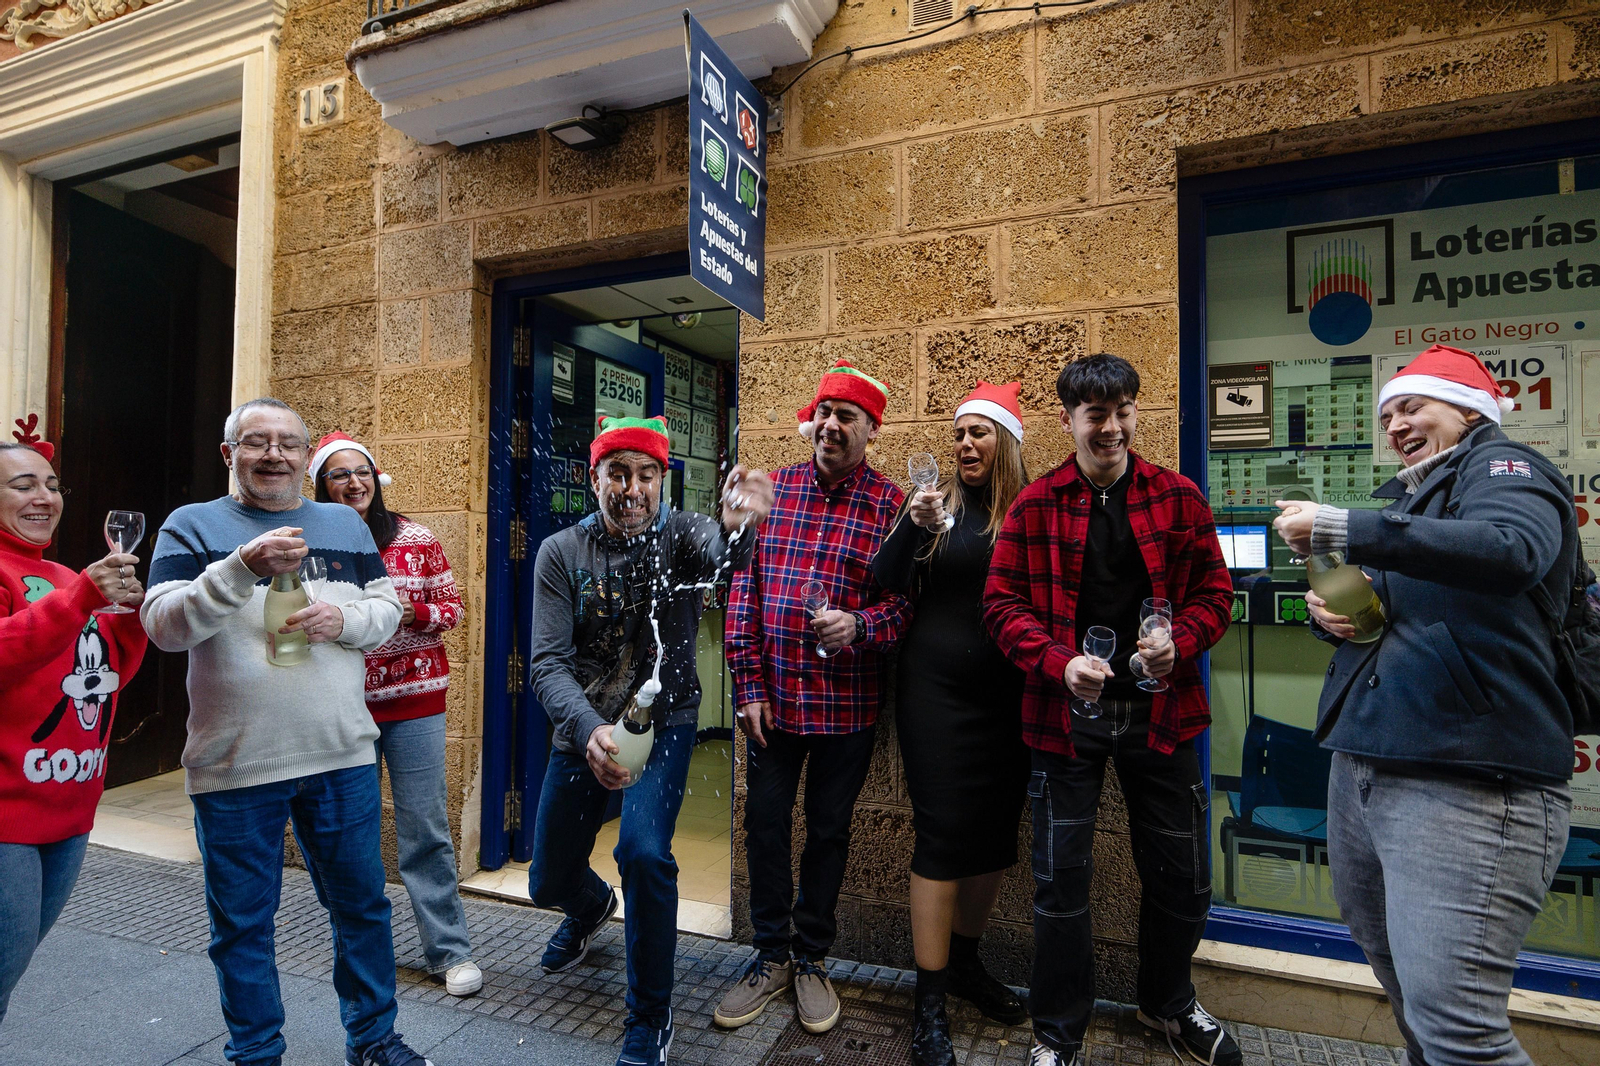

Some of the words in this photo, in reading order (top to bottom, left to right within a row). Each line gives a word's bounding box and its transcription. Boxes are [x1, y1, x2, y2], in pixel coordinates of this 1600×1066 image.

[741, 228, 747, 246] y
[1410, 215, 1598, 261] Loterías
[700, 220, 744, 266] Apuestas
[745, 254, 758, 277] del
[700, 248, 733, 285] Estado
[1395, 329, 1412, 345] El
[1421, 327, 1476, 343] Gato
[1486, 321, 1560, 341] Negro
[666, 352, 689, 367] PREMIO
[1478, 348, 1501, 357] AQUÍ
[610, 370, 641, 388] PREMIO
[1227, 376, 1269, 384] VIDEOVIGILADA
[600, 377, 642, 406] 25296
[665, 408, 688, 421] PREMIO
[842, 1020, 894, 1036] PUBLICO
